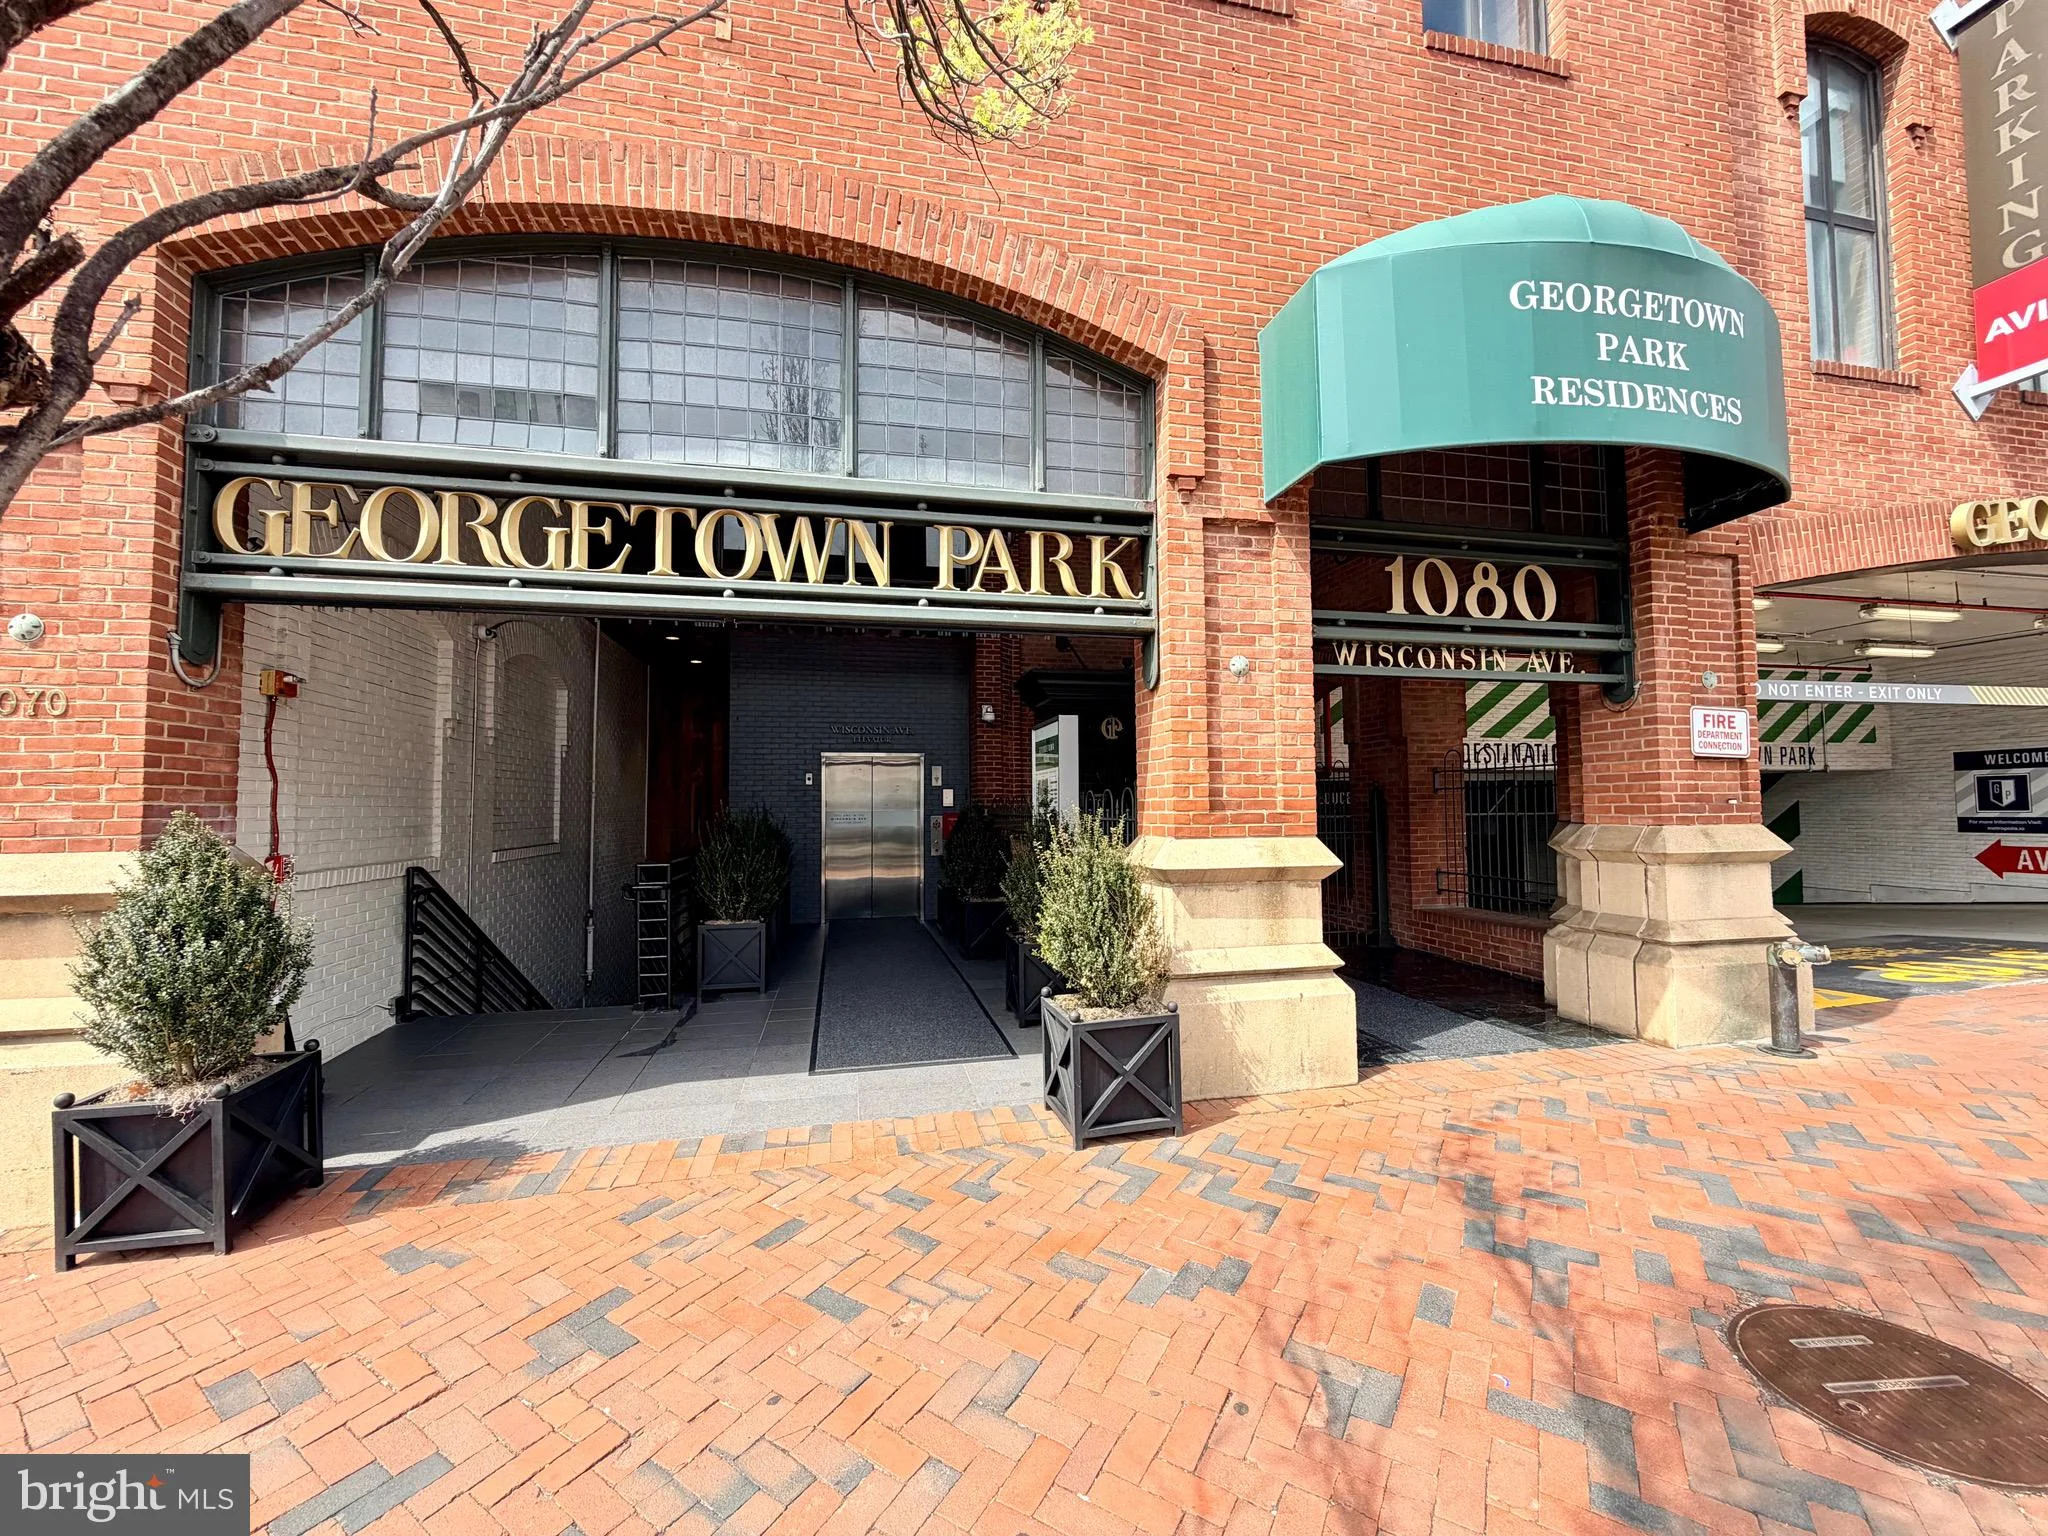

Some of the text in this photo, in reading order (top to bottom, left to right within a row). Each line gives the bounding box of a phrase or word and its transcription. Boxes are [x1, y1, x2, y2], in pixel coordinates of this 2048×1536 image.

[1991, 0, 2047, 268] PARKING
[1509, 280, 1745, 339] GEORGETOWN
[1596, 332, 1690, 371] PARK
[1530, 375, 1743, 425] RESIDENCES
[212, 476, 1145, 599] GEORGETOWN PARK
[1951, 495, 2048, 547] GEO
[1384, 555, 1557, 622] 1080
[1332, 640, 1586, 675] WISCONSIN AVE.
[1768, 683, 1799, 697] NOT
[1805, 684, 1853, 699] ENTER
[1869, 687, 1901, 700] EXIT
[1906, 687, 1942, 701] ONLY
[831, 724, 890, 734] WISCONSIN
[1697, 730, 1743, 740] DEPARTMENT
[1703, 714, 1737, 730] FIRE
[1698, 740, 1743, 751] CONNECTION
[1780, 746, 1816, 765] PARK
